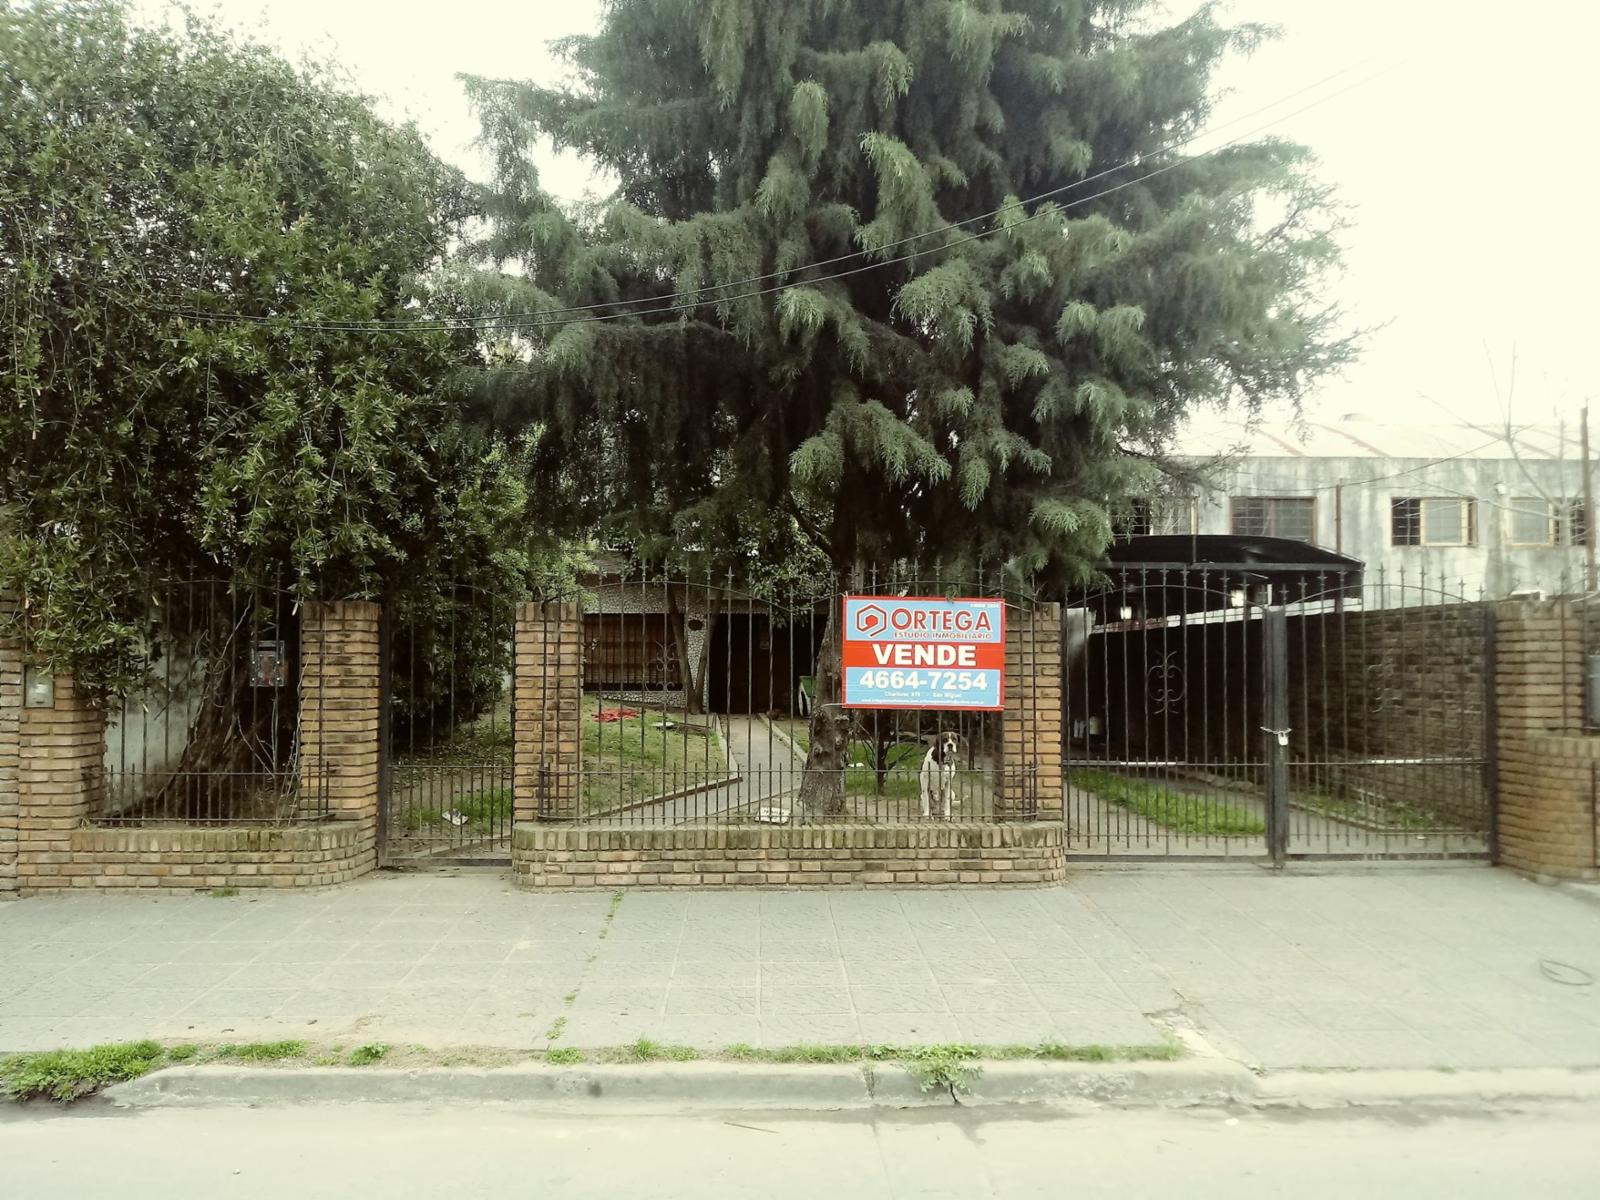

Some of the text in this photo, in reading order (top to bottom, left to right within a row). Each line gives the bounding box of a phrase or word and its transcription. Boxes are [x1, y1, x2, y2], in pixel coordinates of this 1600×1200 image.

[891, 608, 992, 632] ORTEGA
[872, 643, 977, 667] VENDE
[859, 670, 988, 691] 4664-7254
